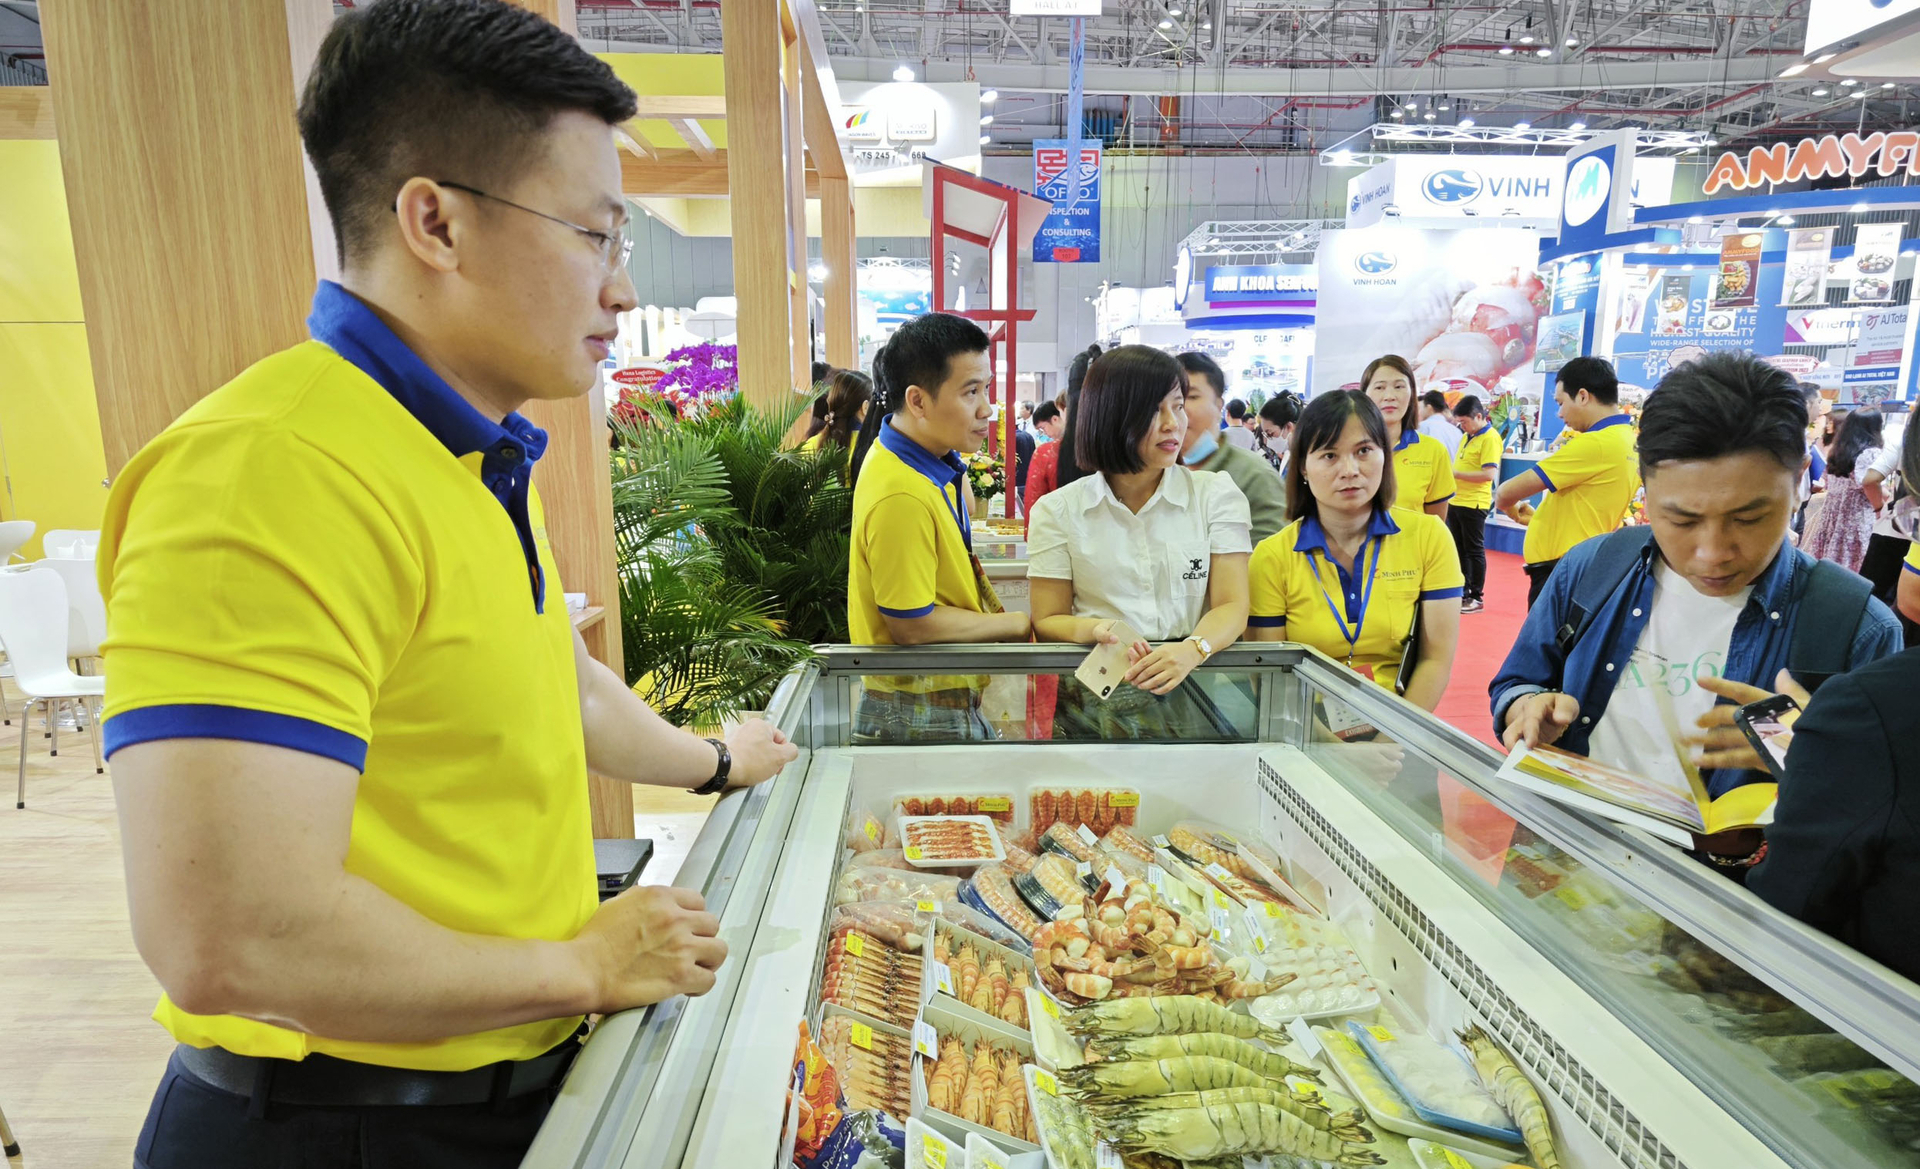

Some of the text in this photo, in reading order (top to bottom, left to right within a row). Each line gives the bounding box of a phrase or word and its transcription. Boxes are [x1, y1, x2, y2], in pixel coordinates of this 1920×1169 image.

[875, 151, 890, 160] 245
[1489, 177, 1550, 198] VINH
[1044, 187, 1091, 199] OFO
[1361, 191, 1374, 205] VINH
[1048, 207, 1090, 216] NSPETION
[1063, 217, 1070, 226] &
[1041, 228, 1092, 236] CONSULTING
[1240, 275, 1275, 292] KHOA
[1353, 278, 1397, 286] VINH HOAN
[1891, 312, 1908, 324] Tota
[1650, 339, 1699, 347] WIDE-RANGE
[616, 375, 662, 383] Congratulation
